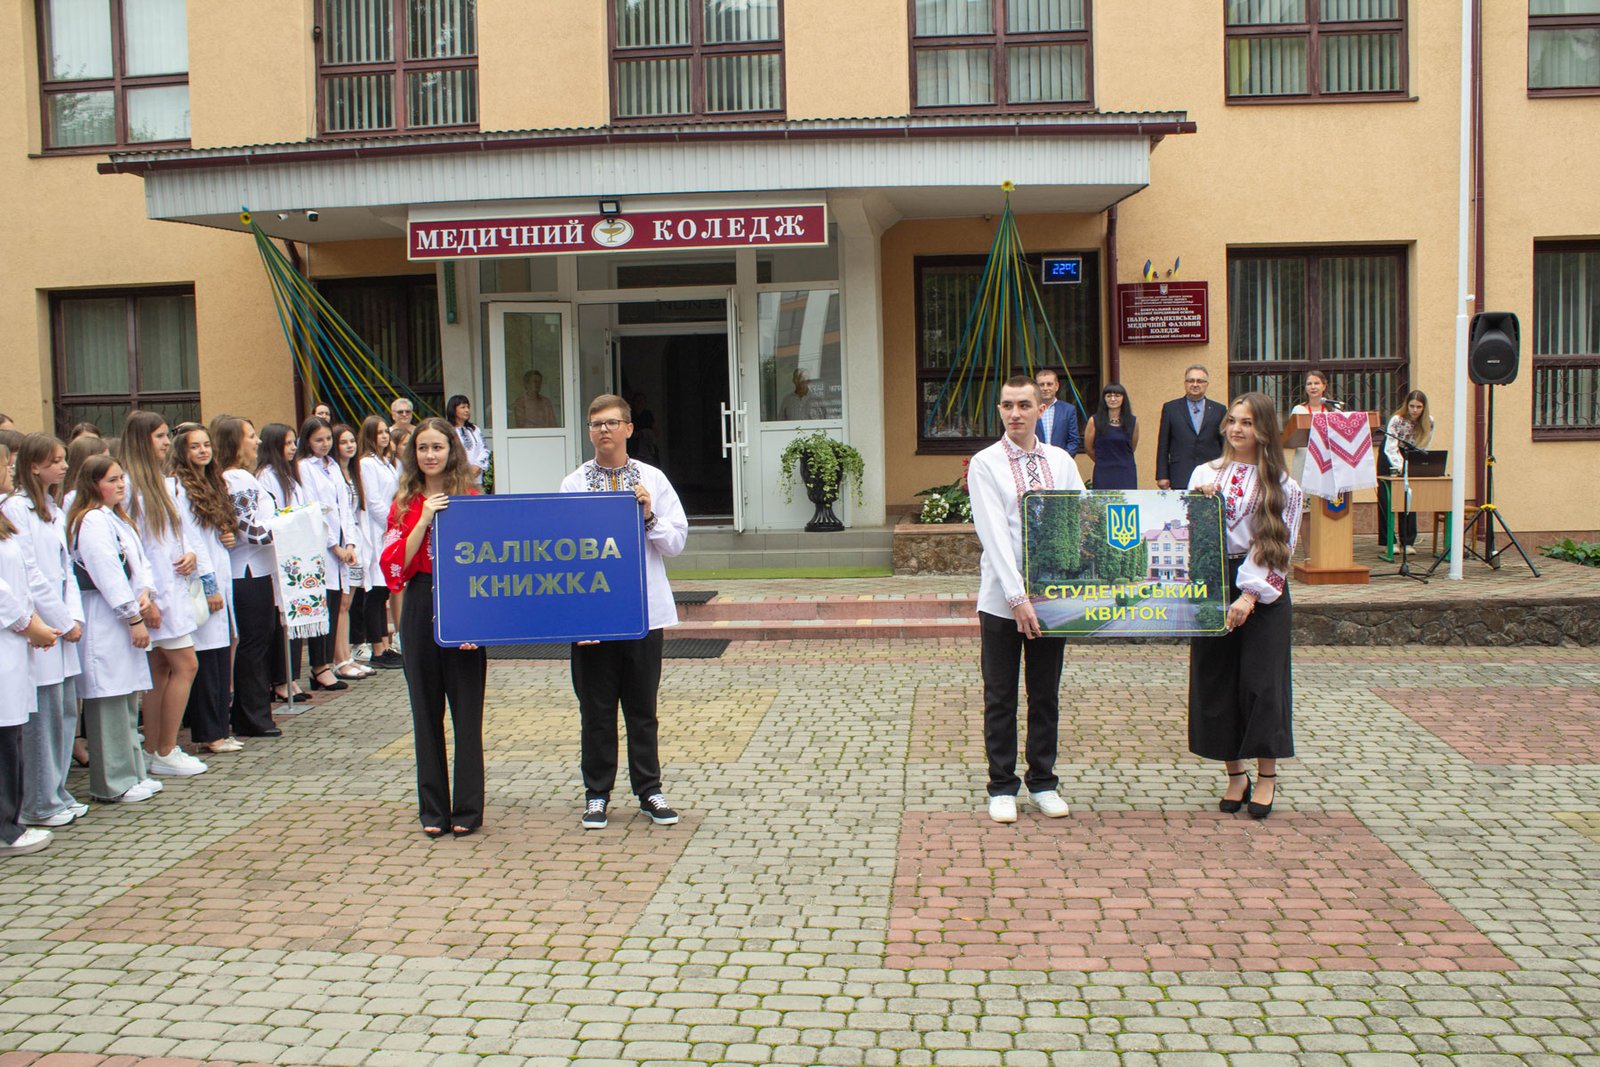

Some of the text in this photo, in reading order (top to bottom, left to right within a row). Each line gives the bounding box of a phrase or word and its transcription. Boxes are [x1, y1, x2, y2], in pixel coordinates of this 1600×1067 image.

[416, 214, 805, 254] МЕДИЧНИЙ КОЛЕДЖ
[454, 537, 622, 564] ЗАЛІКОВА
[469, 571, 611, 598] КНИЖКА
[1045, 578, 1208, 600] СТУДЕНТСЬКИЙ
[1085, 606, 1168, 621] КВИТОК
